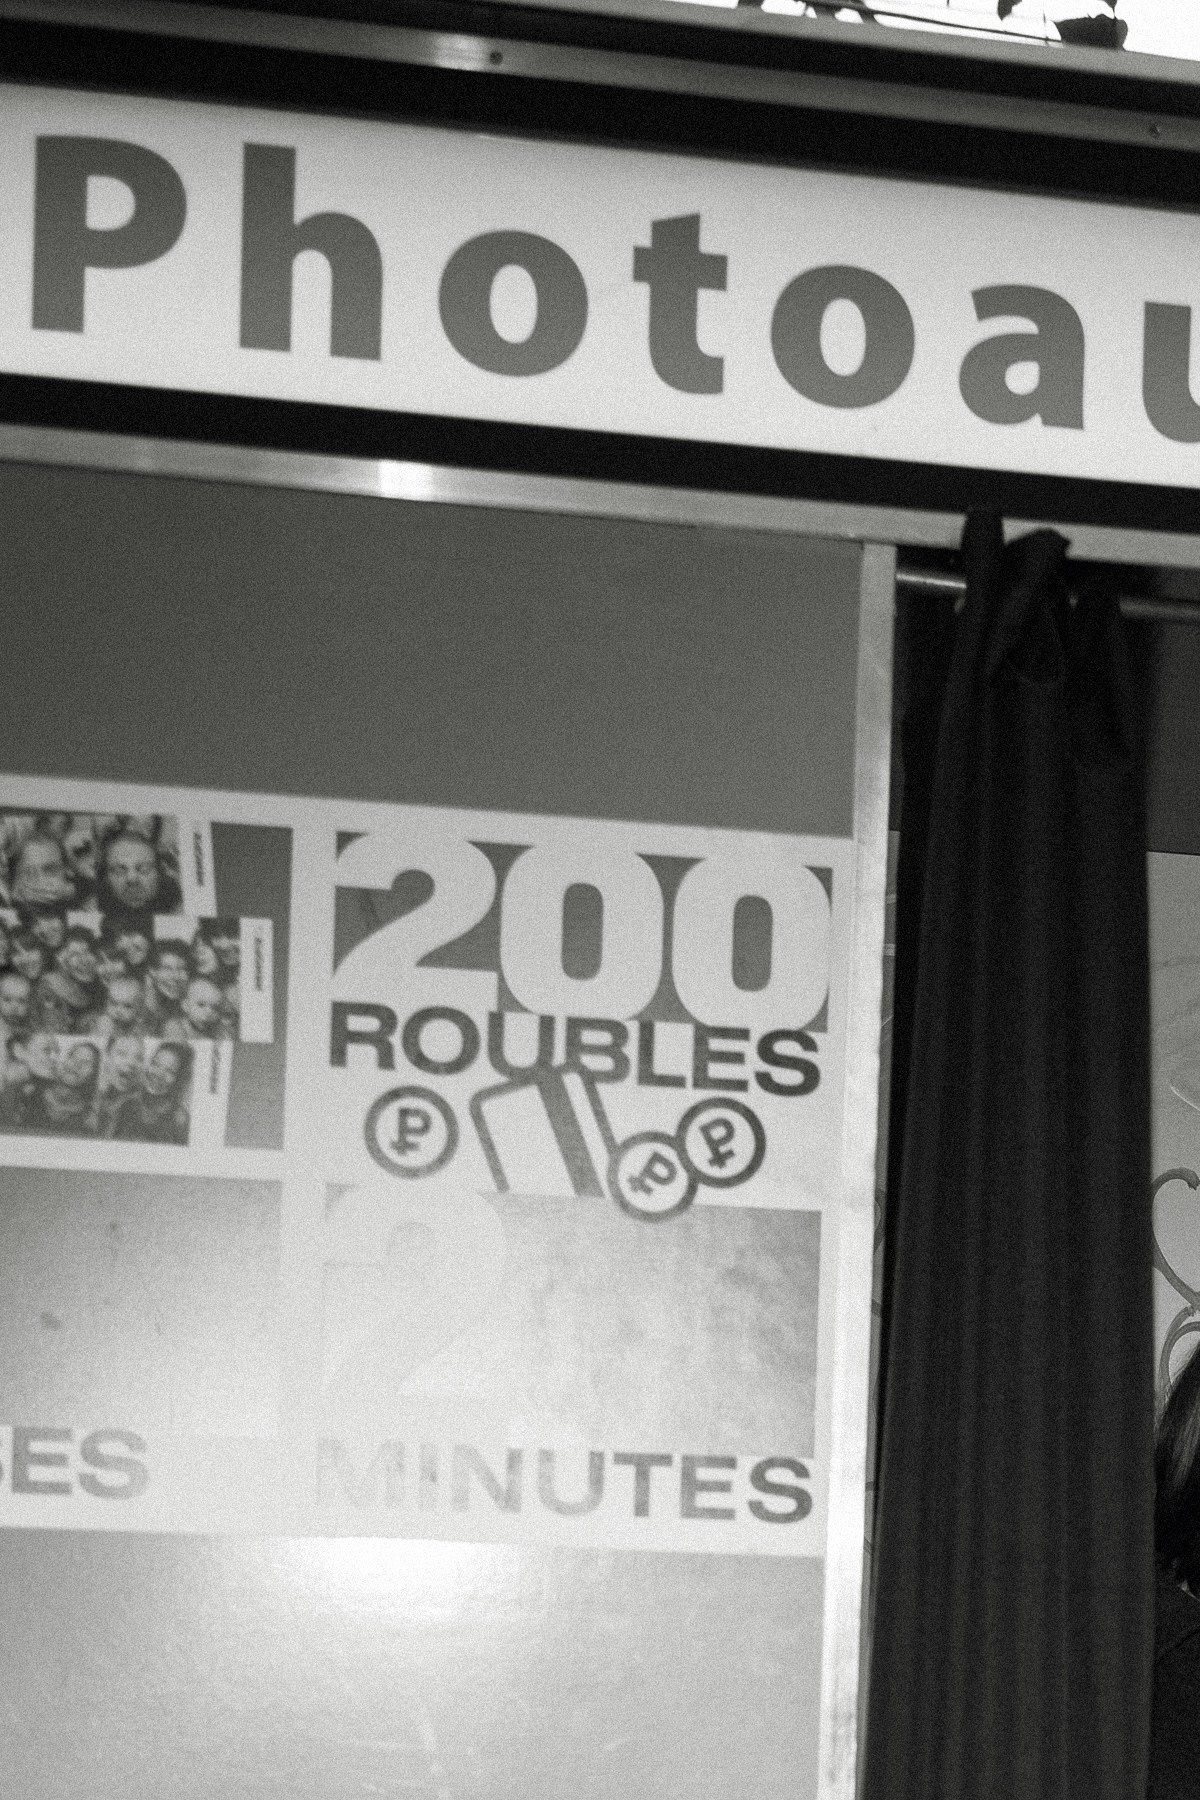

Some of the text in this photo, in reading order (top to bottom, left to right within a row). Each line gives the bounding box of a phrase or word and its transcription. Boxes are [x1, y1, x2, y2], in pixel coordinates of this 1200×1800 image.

[332, 822, 833, 1030] 200
[328, 1000, 823, 1098] ROUBLES
[0, 1426, 150, 1500] ES
[313, 1436, 814, 1525] MINUTES
